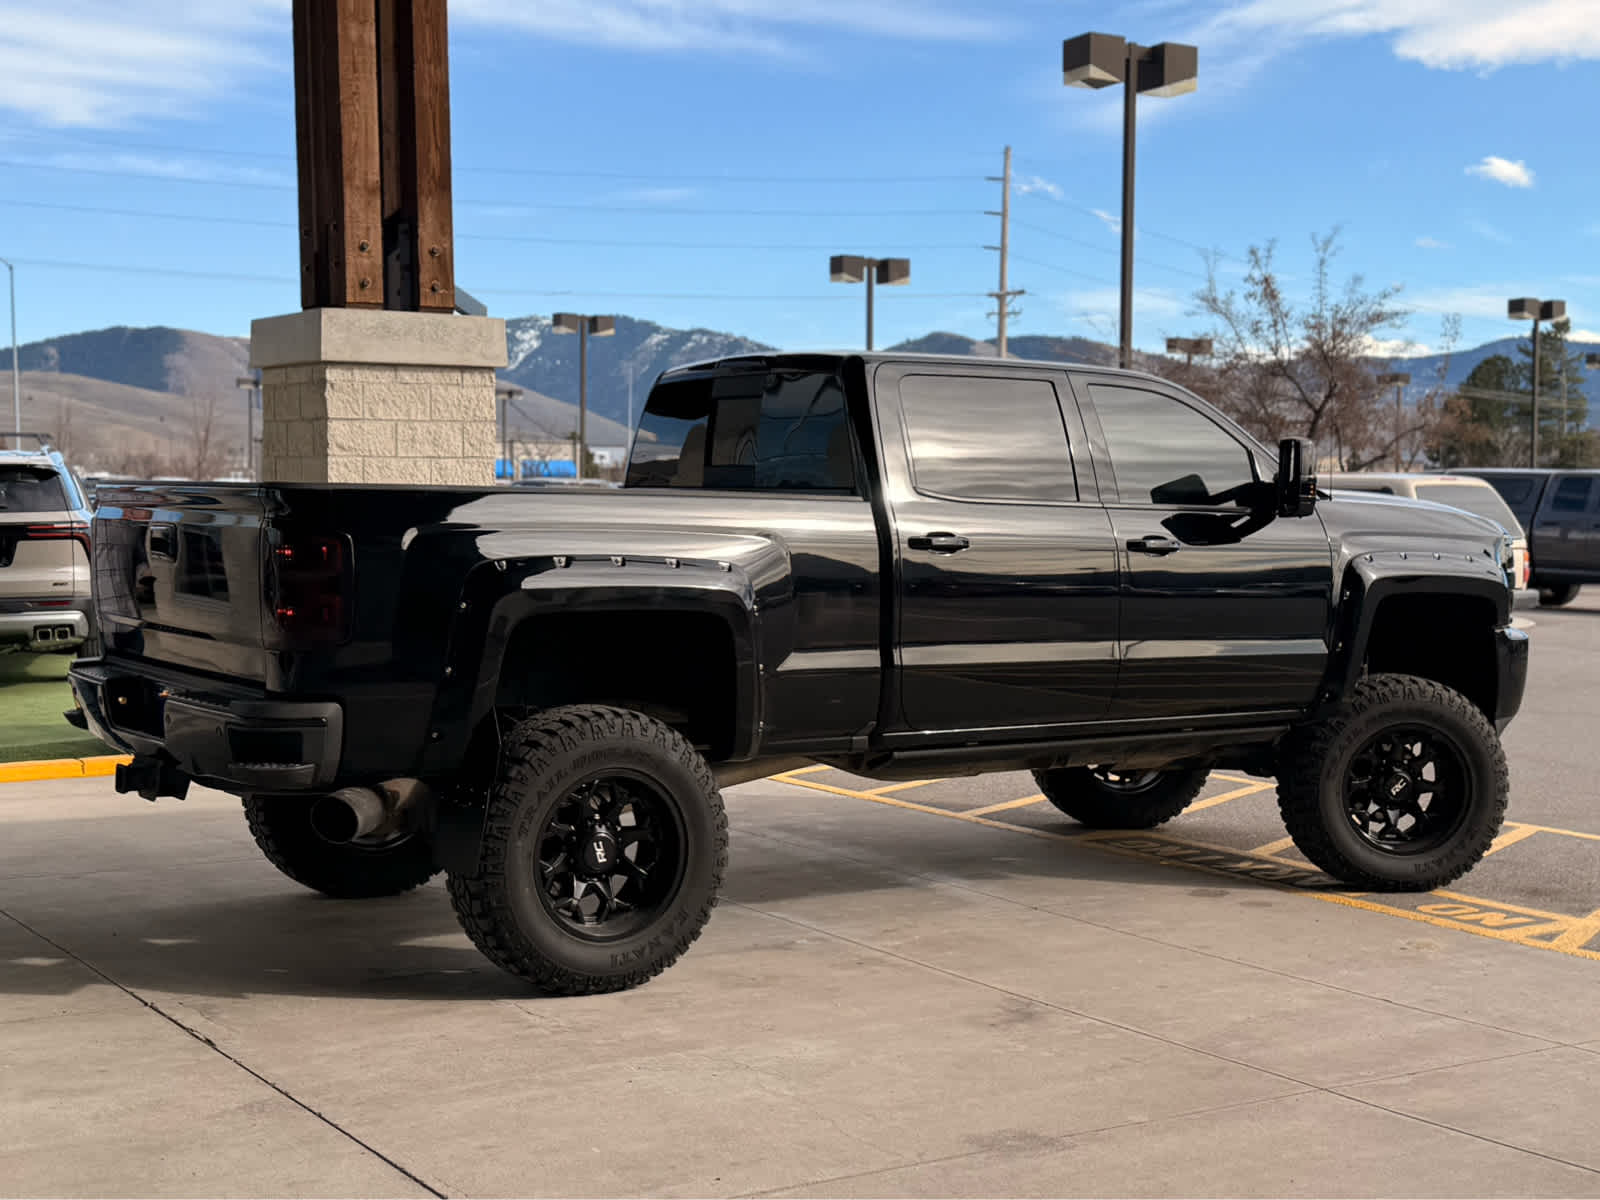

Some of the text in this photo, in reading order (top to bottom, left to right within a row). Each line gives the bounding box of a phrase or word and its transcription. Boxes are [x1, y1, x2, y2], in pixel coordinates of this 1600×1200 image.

[1390, 778, 1407, 796] RC
[592, 840, 608, 864] RC
[1105, 838, 1537, 928] NO ARKING
